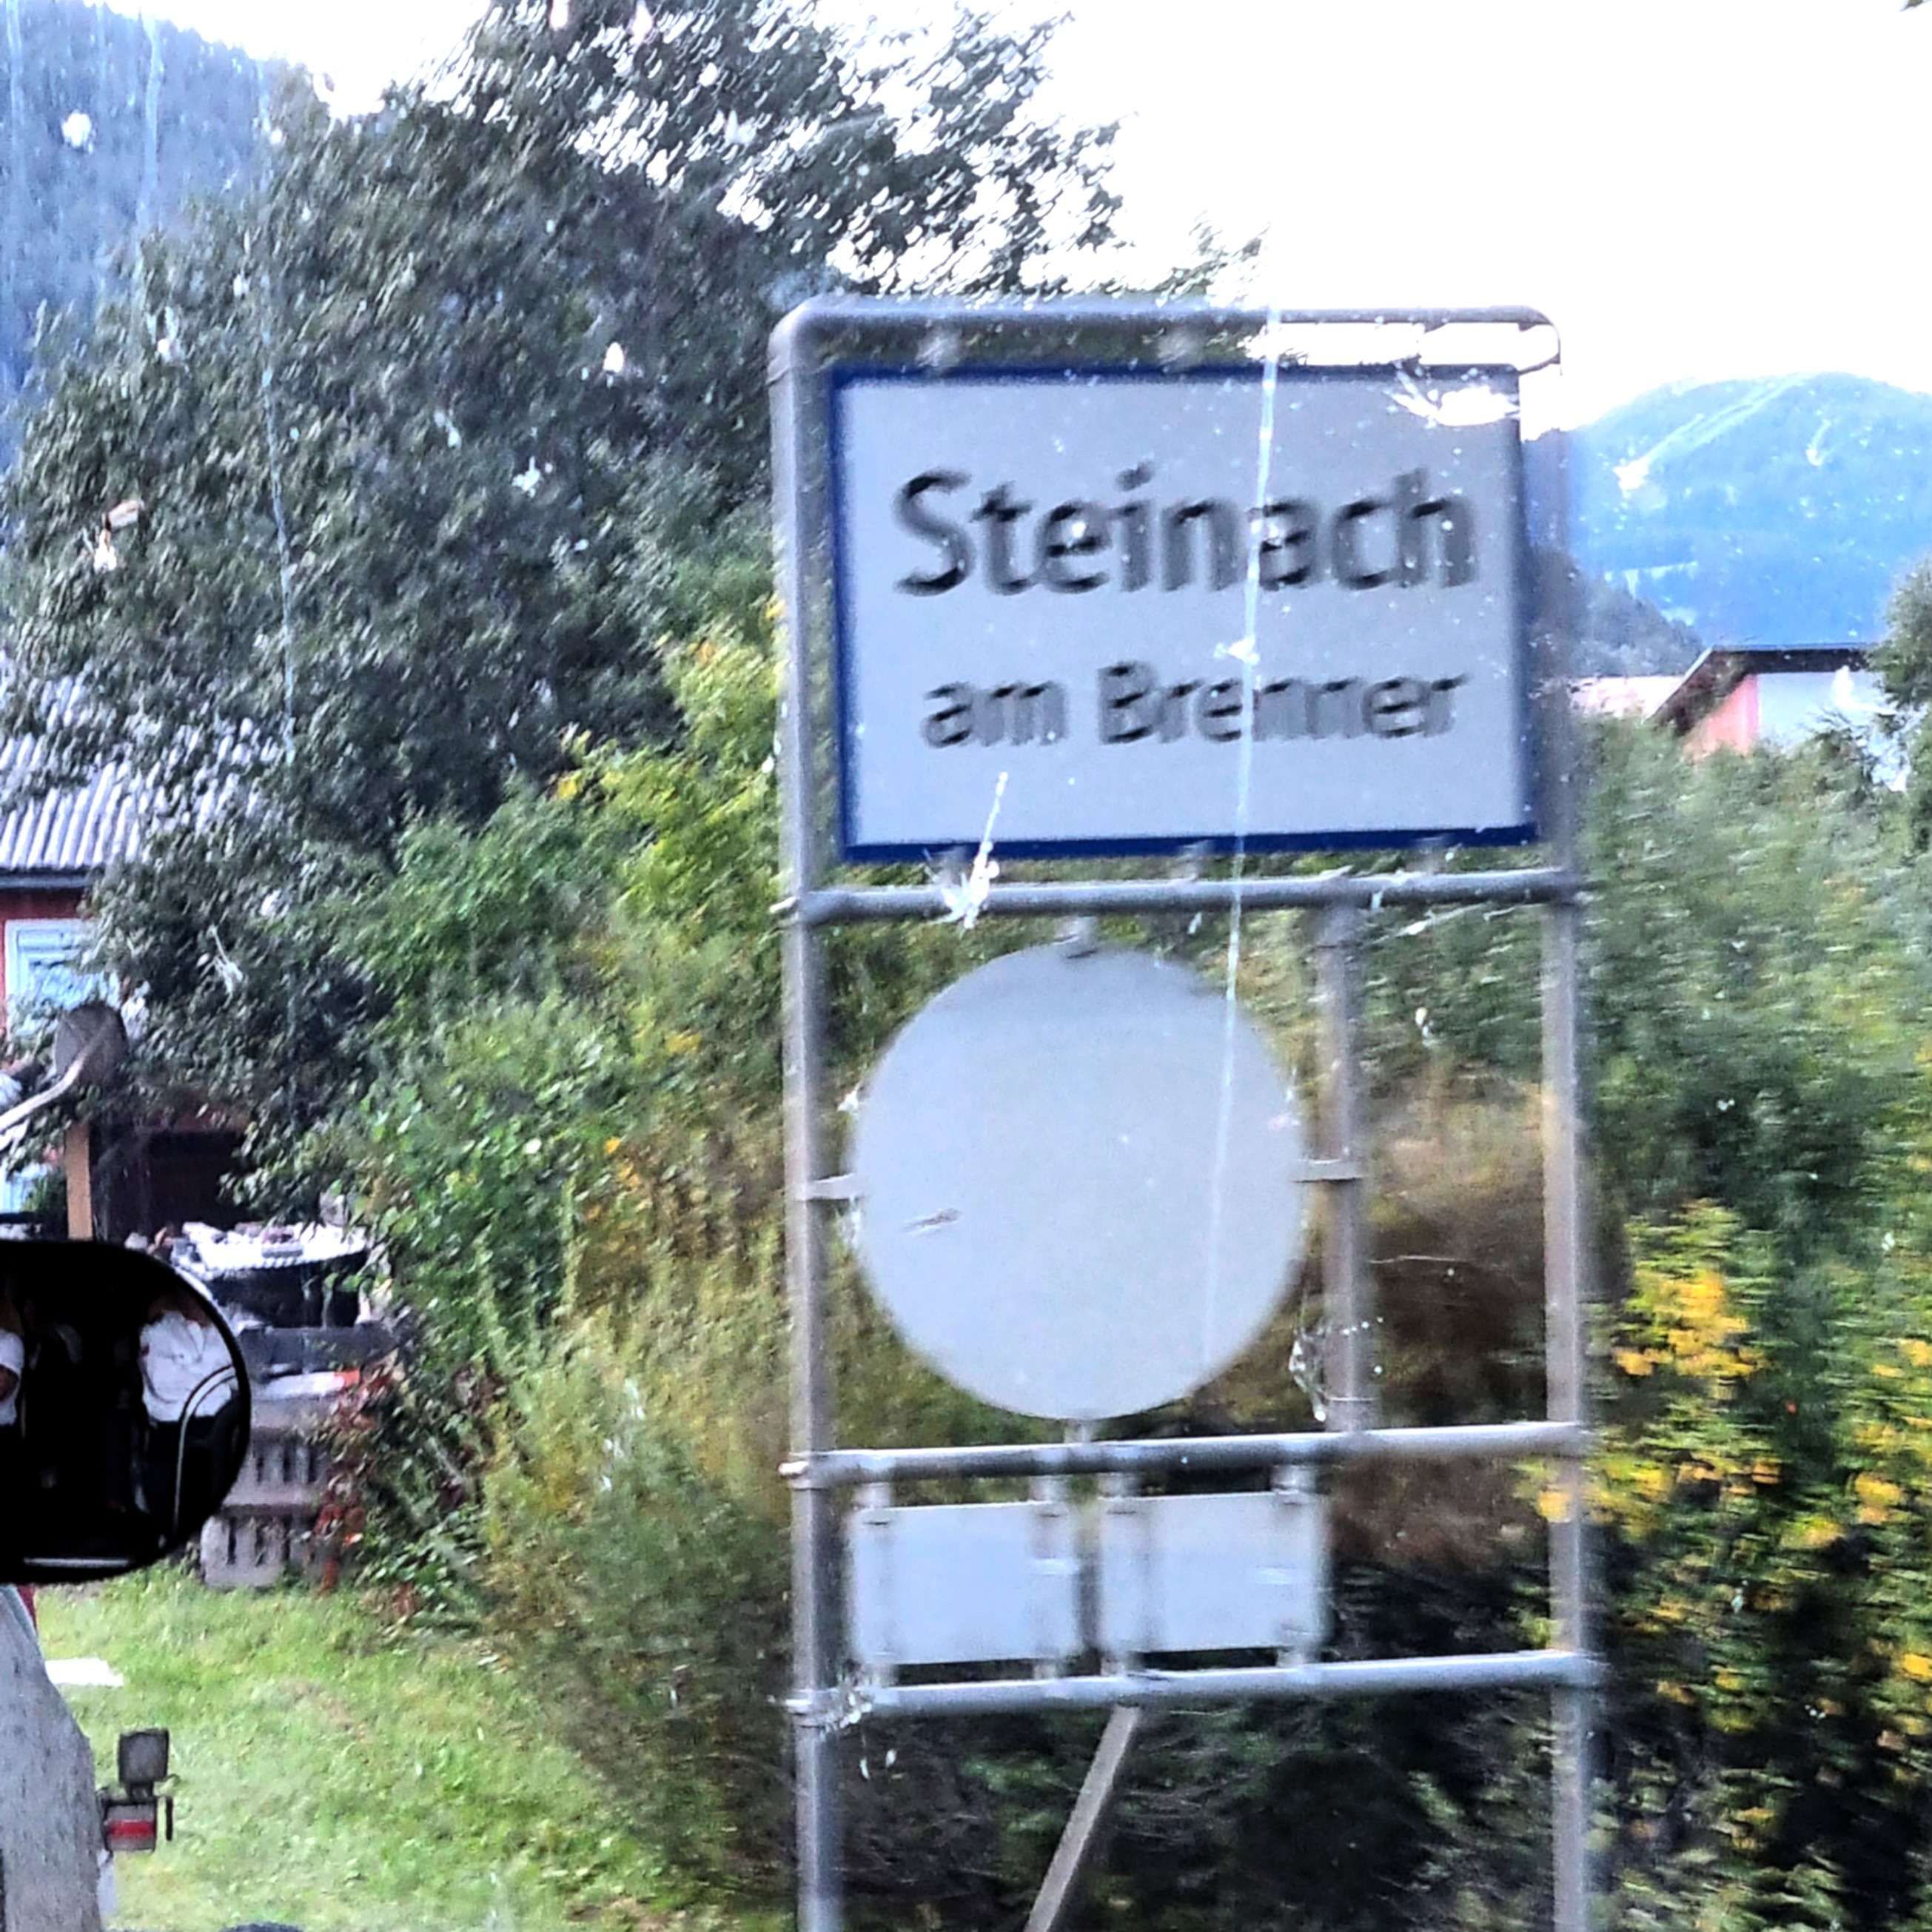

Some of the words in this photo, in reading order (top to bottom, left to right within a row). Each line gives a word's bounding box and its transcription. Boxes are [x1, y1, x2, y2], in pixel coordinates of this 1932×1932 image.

[893, 463, 1477, 594] Steinach
[922, 680, 1066, 748] am
[1098, 660, 1469, 743] Brenner
